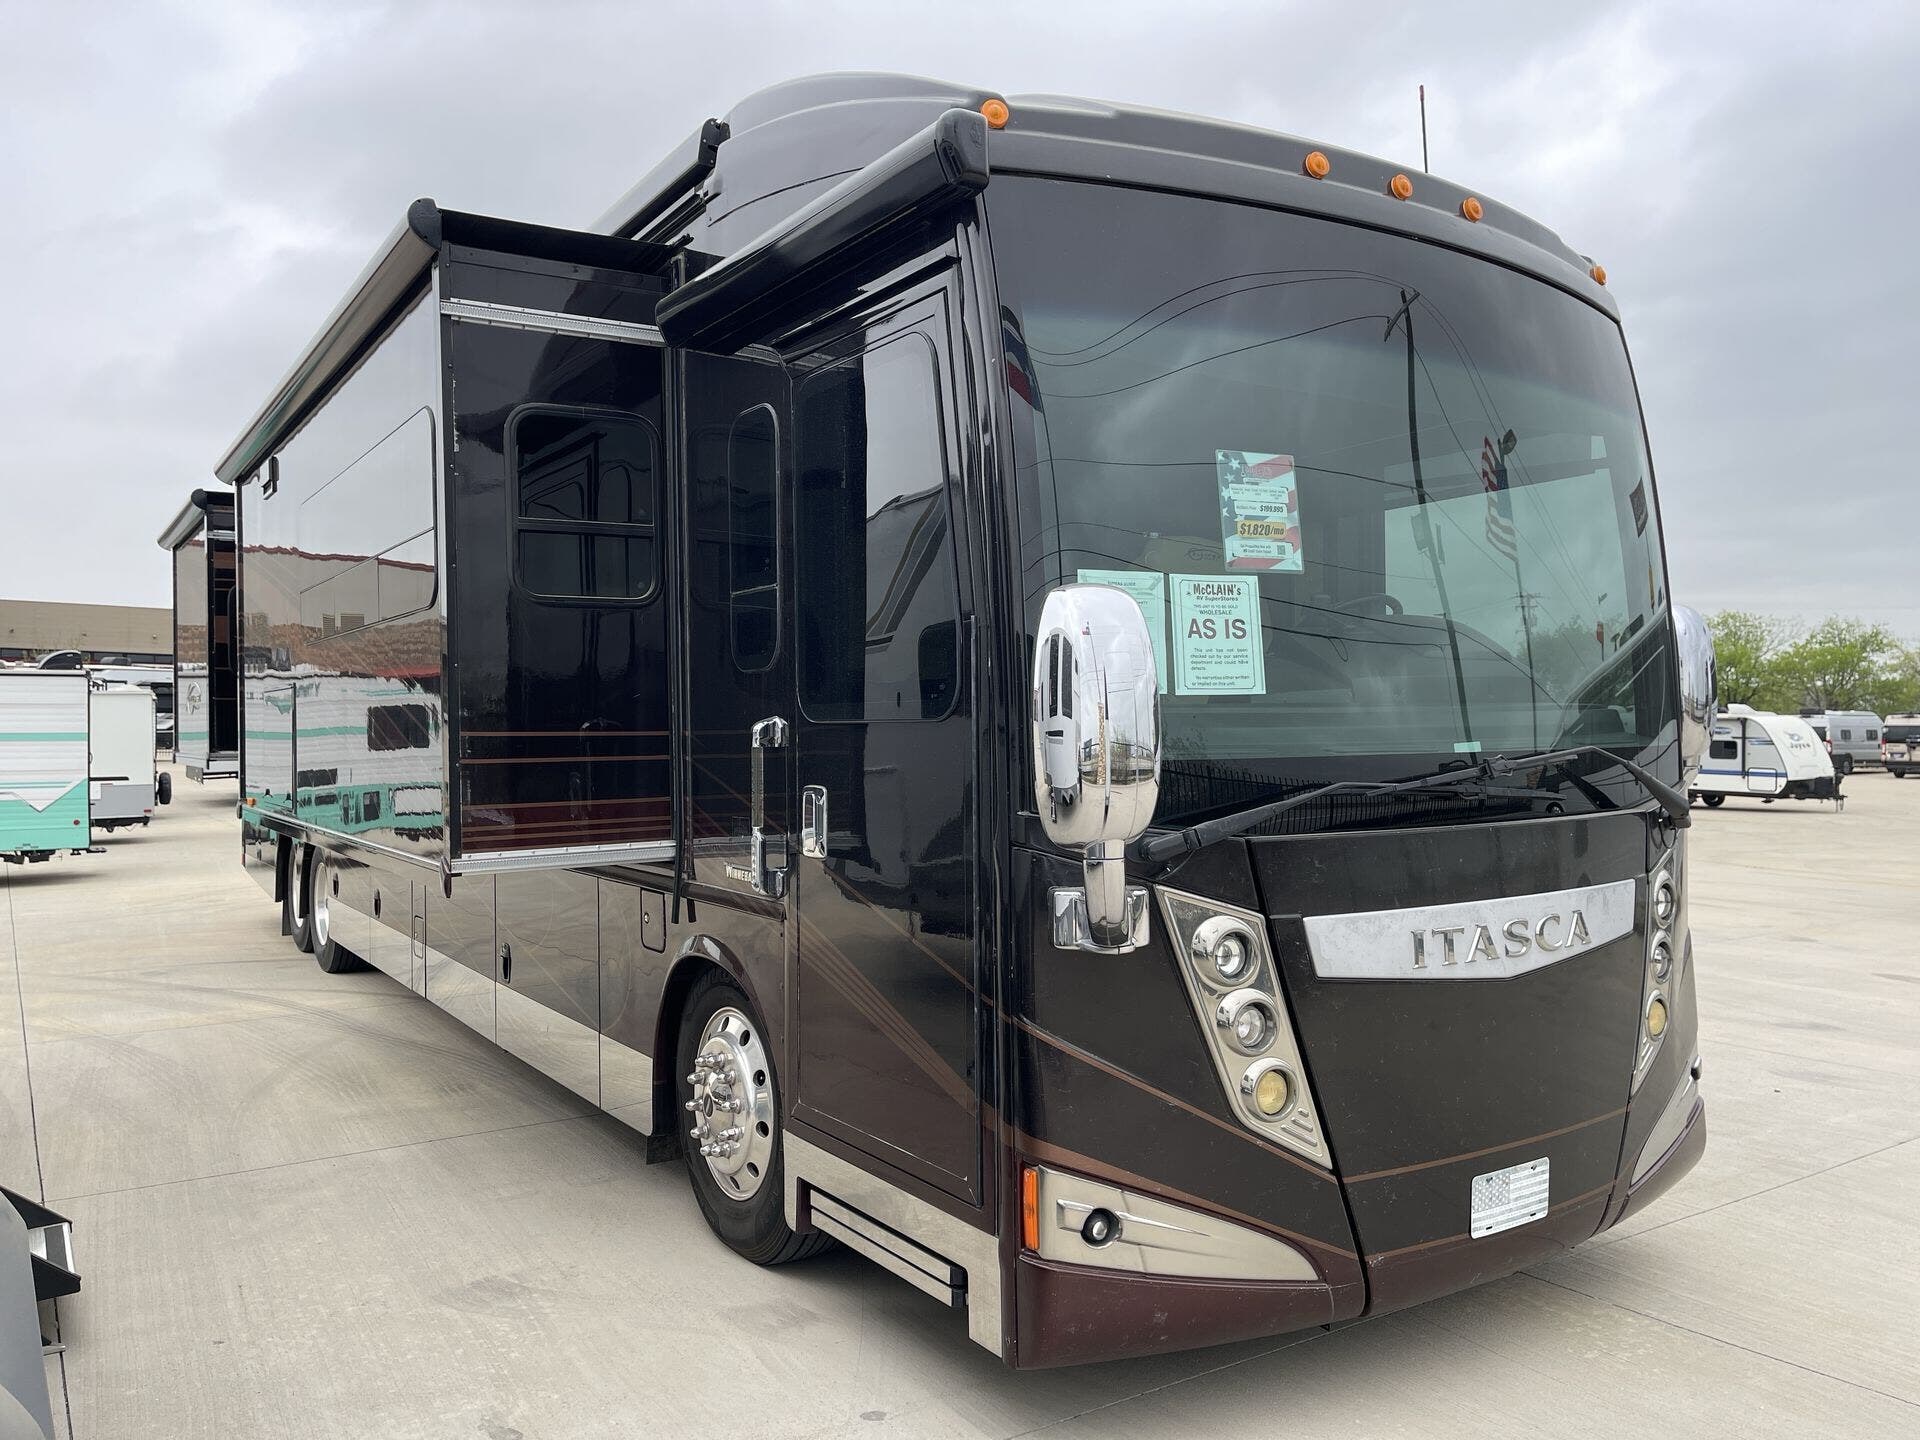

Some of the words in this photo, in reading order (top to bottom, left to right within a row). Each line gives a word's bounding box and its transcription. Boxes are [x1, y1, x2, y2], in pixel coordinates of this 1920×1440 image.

[1240, 523, 1285, 536] $1,820/mo
[1188, 618, 1217, 640] AS
[1224, 618, 1247, 640] IS
[1410, 909, 1593, 970] ITASCA
